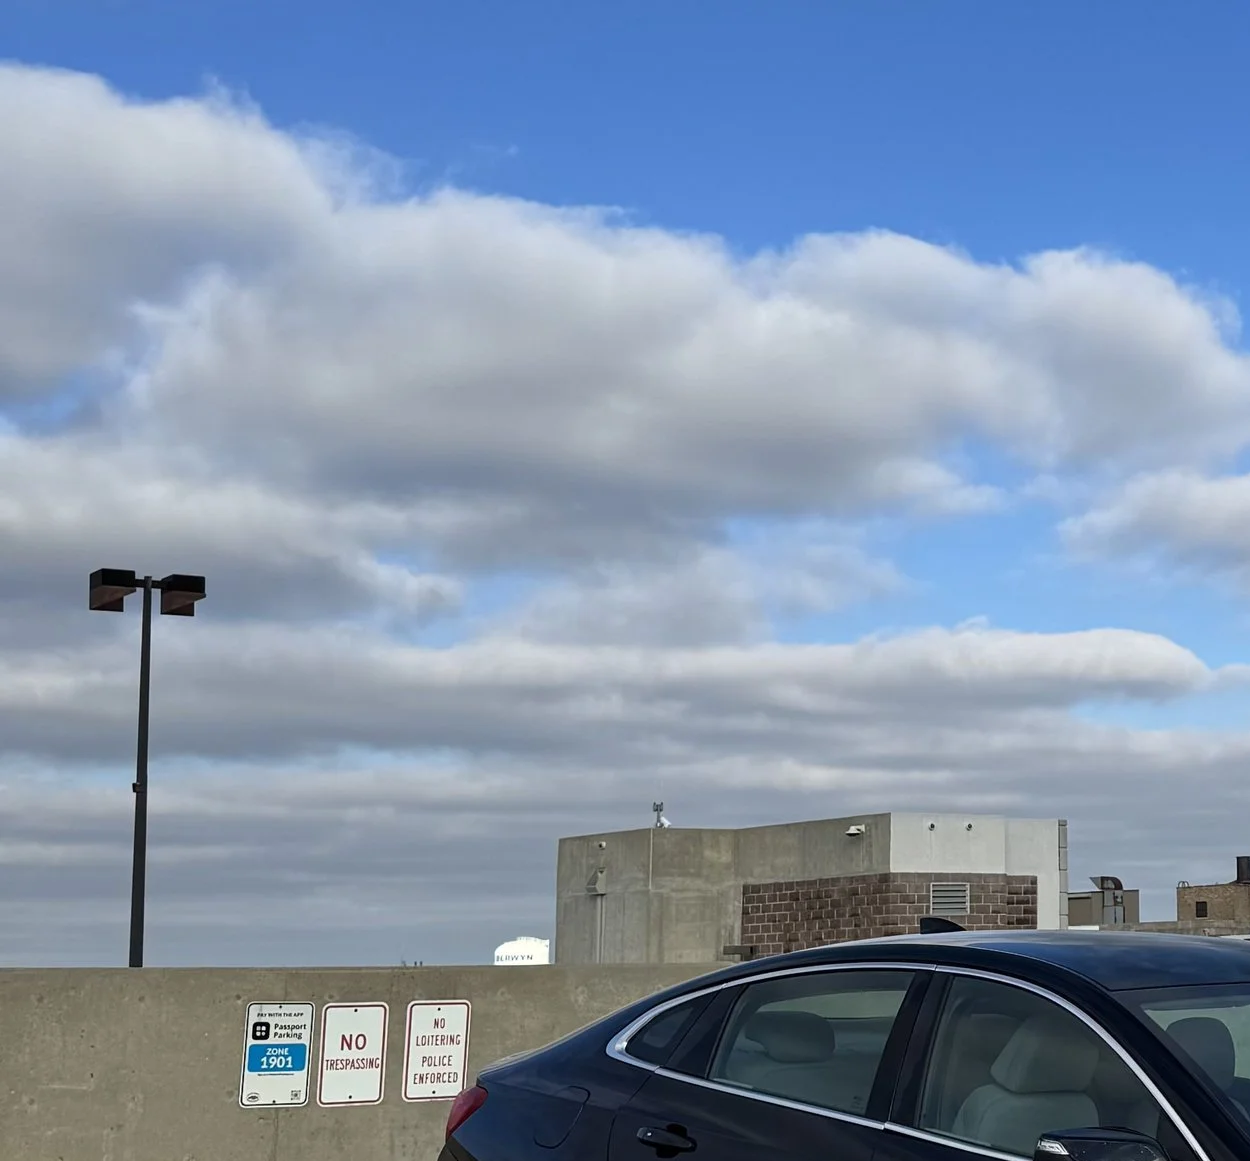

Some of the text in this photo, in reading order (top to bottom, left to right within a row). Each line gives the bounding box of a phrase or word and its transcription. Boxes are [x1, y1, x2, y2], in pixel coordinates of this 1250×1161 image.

[274, 1023, 307, 1031] Passport
[433, 1018, 446, 1029] NO
[274, 1032, 302, 1040] Parking
[340, 1034, 367, 1050] NO
[416, 1034, 460, 1046] LOITERING
[261, 1056, 293, 1068] 1901
[325, 1057, 380, 1071] TRESPASSING
[422, 1055, 452, 1067] POLICE
[413, 1072, 458, 1084] ENFORCED
